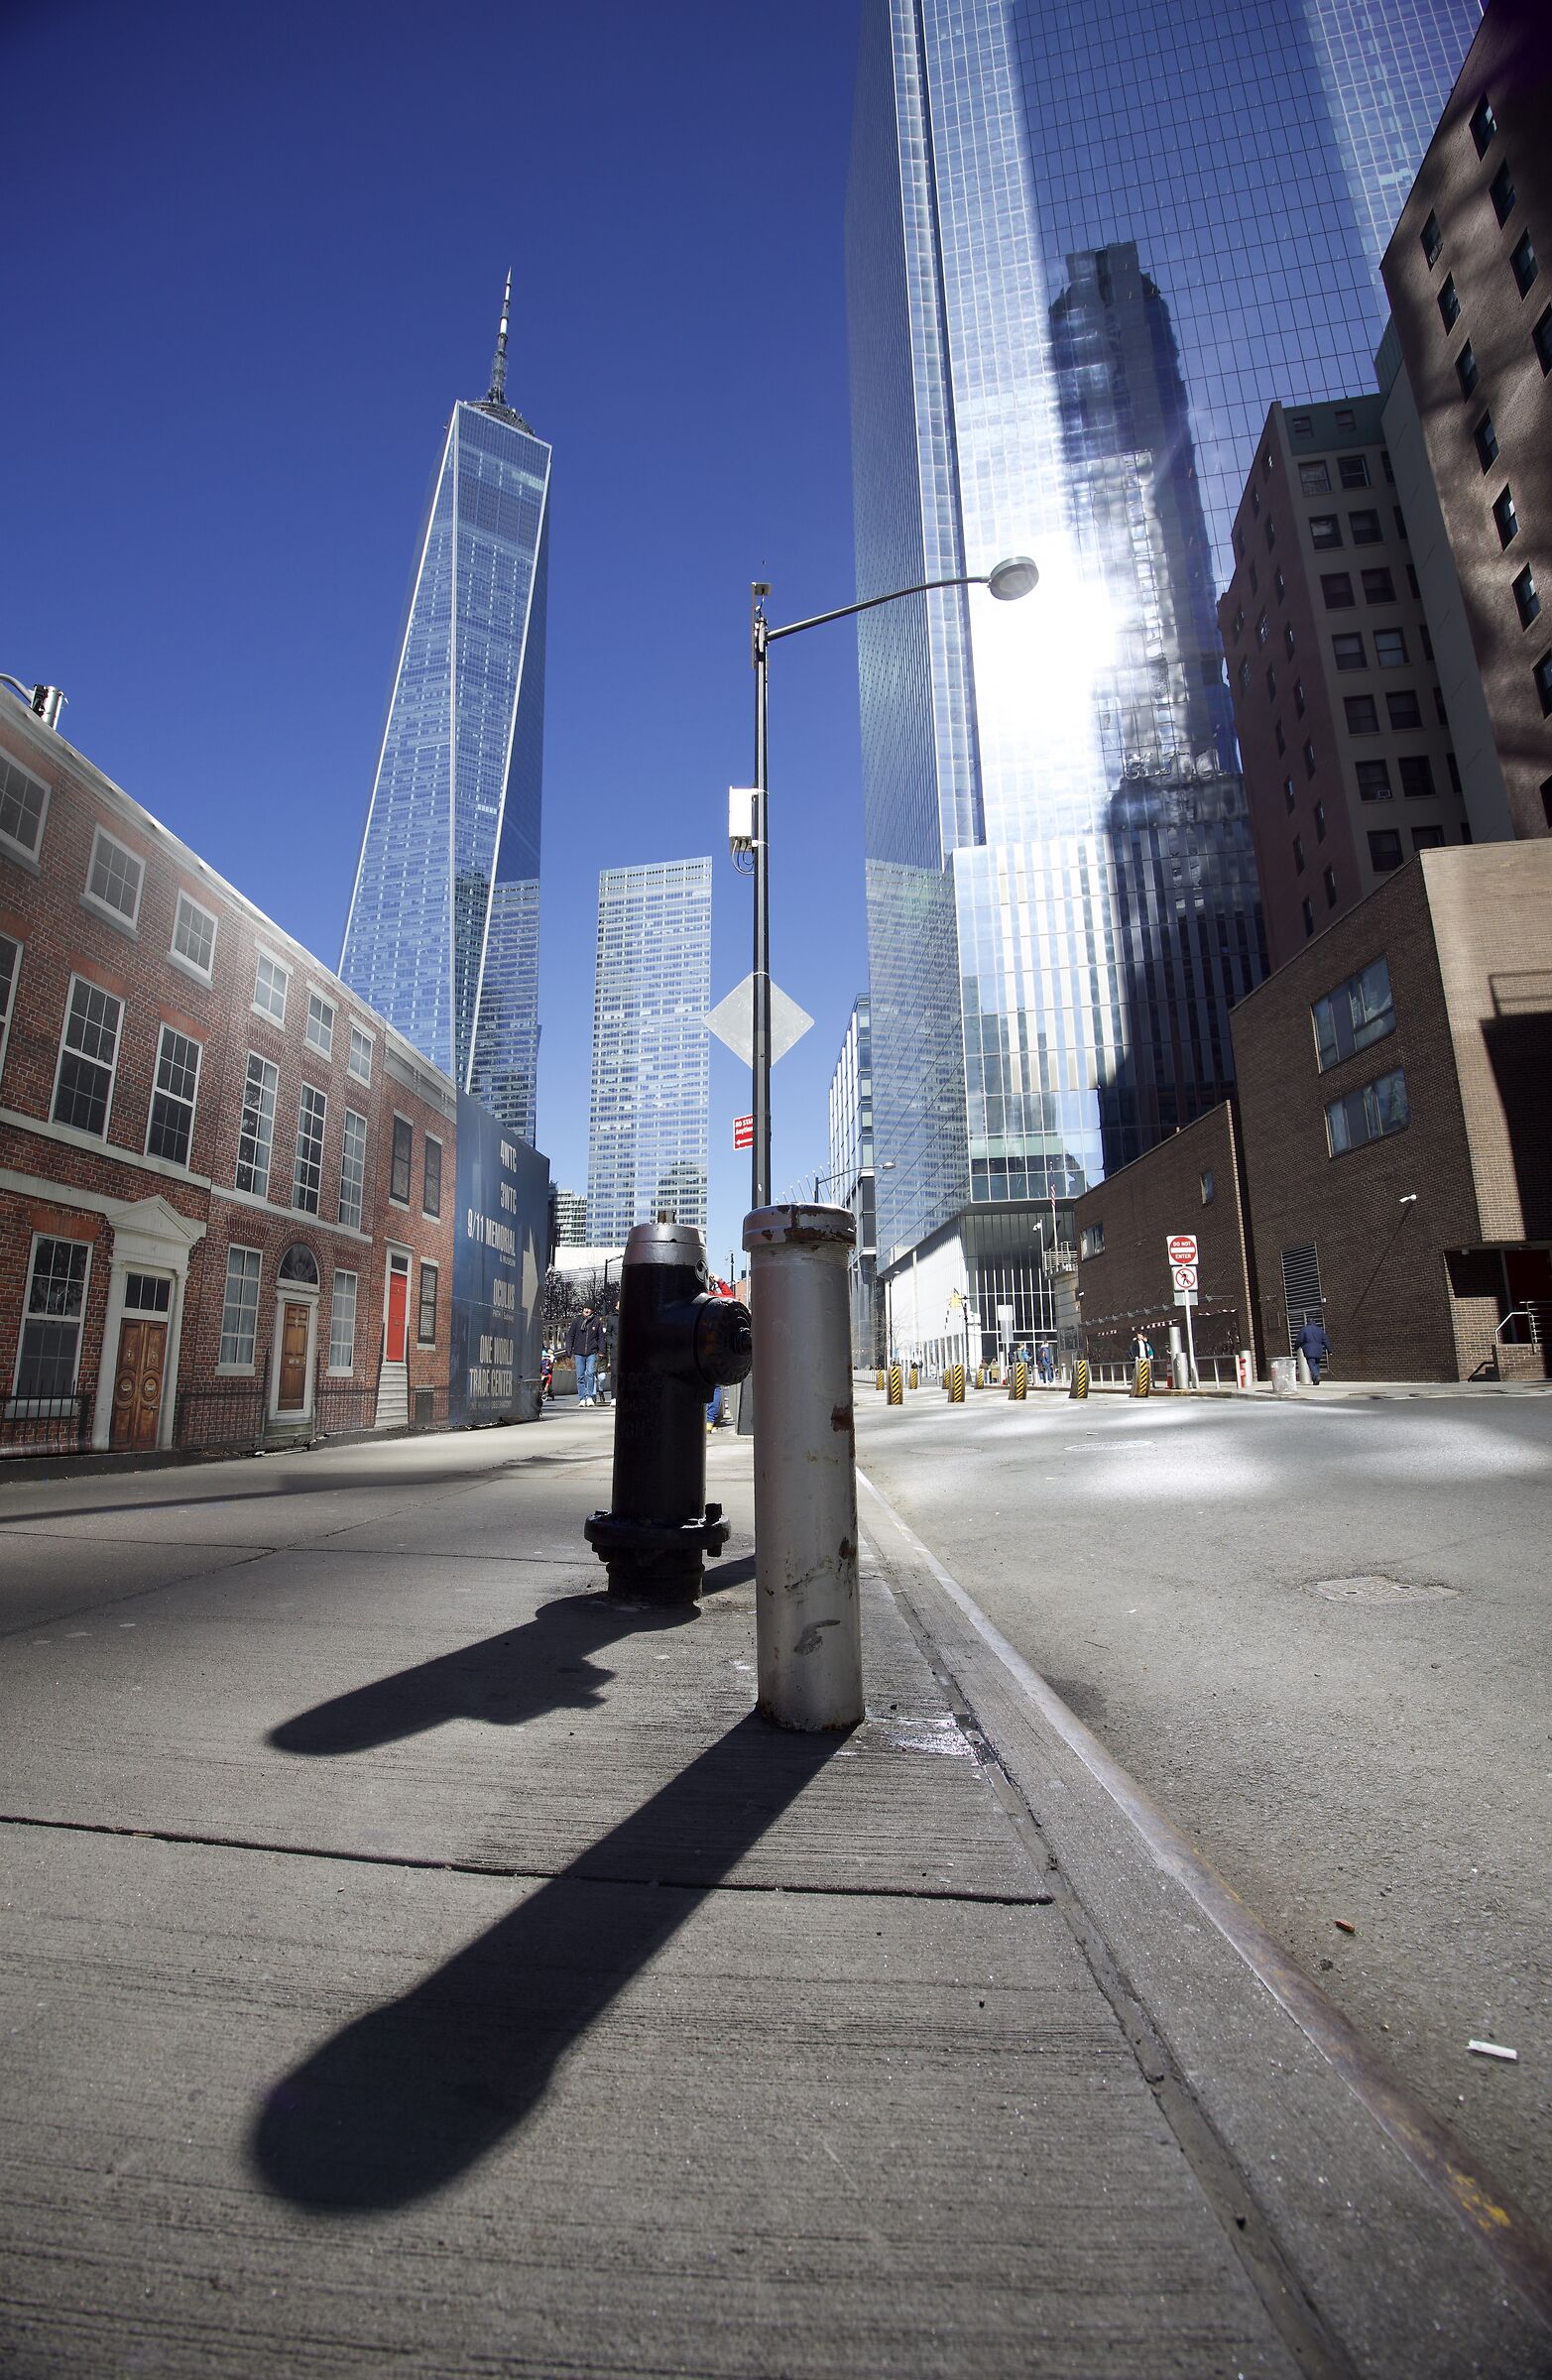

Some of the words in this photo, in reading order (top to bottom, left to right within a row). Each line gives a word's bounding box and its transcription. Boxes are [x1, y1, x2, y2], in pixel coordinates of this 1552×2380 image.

[500, 1138, 517, 1173] 4WTC
[500, 1181, 517, 1215] 3WTC
[467, 1208, 484, 1243] 9/11
[486, 1218, 516, 1256] MEMORIAL
[493, 1277, 515, 1311] OCULUS
[479, 1334, 493, 1365] ONE
[494, 1337, 513, 1366] WORLD
[469, 1368, 490, 1397] TRADE
[491, 1368, 513, 1397] CENTER
